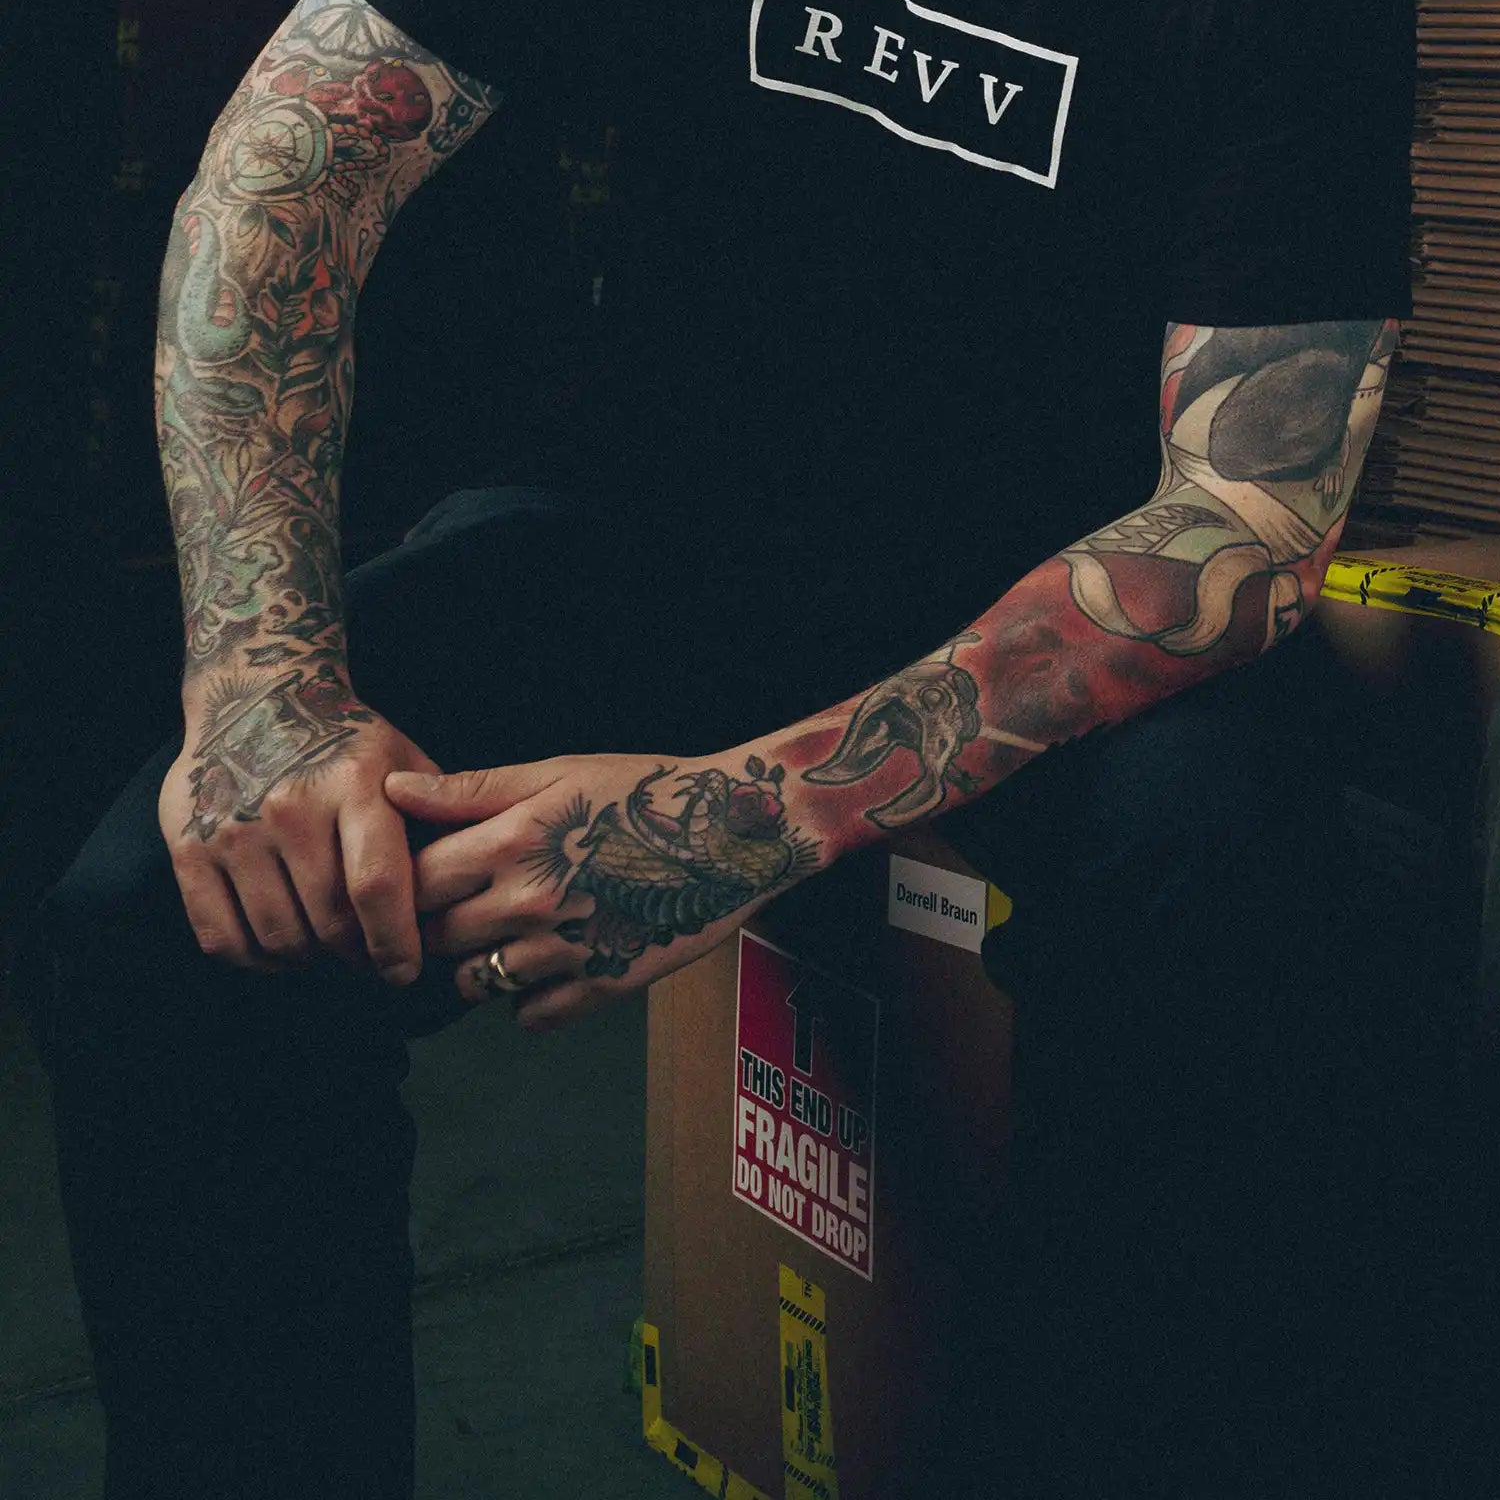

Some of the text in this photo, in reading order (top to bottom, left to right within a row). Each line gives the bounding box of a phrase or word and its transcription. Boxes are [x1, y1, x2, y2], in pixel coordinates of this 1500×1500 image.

[795, 6, 1023, 125] REVV
[897, 883, 977, 925] Darrell Braun
[740, 1047, 870, 1154] THIS END UP
[737, 1154, 867, 1262] DO NOT DROP
[738, 1094, 868, 1223] FRAGILE
